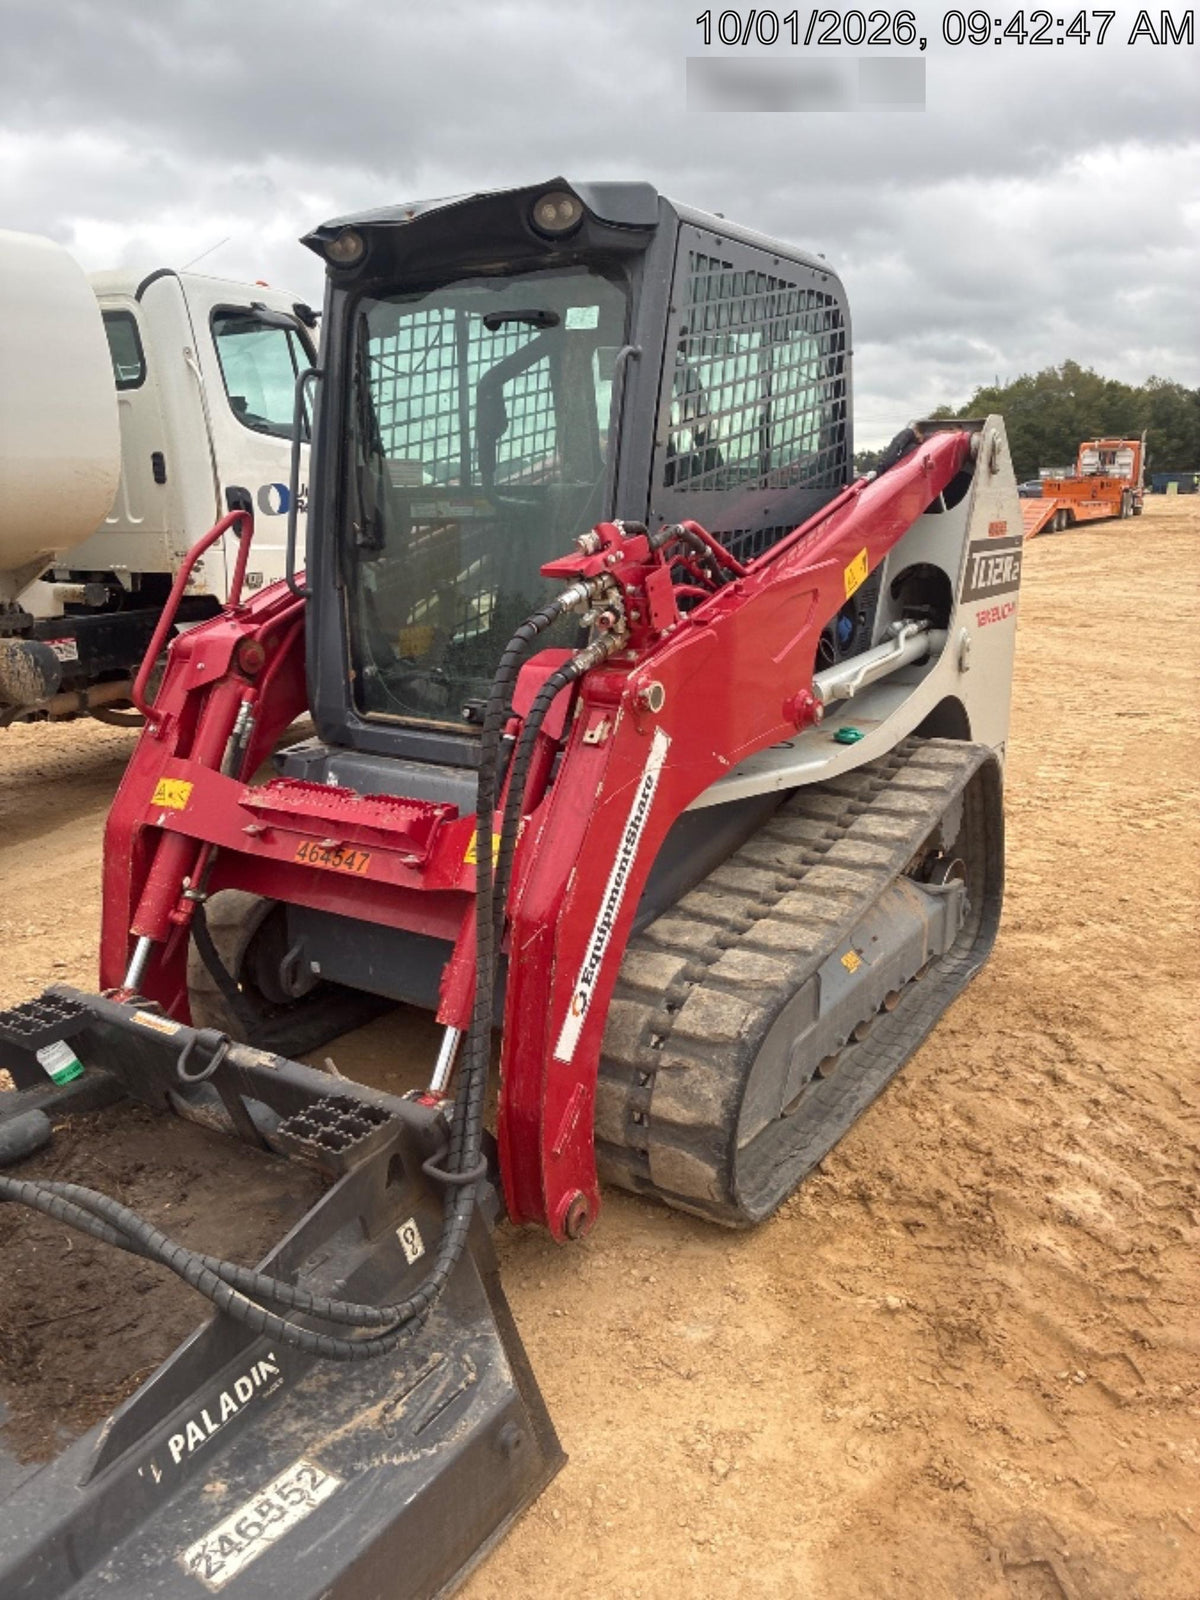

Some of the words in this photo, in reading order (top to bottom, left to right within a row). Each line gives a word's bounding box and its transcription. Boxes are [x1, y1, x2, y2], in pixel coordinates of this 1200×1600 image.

[297, 842, 371, 872] 464547
[580, 774, 655, 988] EquipmentShare
[168, 1352, 281, 1465] PALADIN
